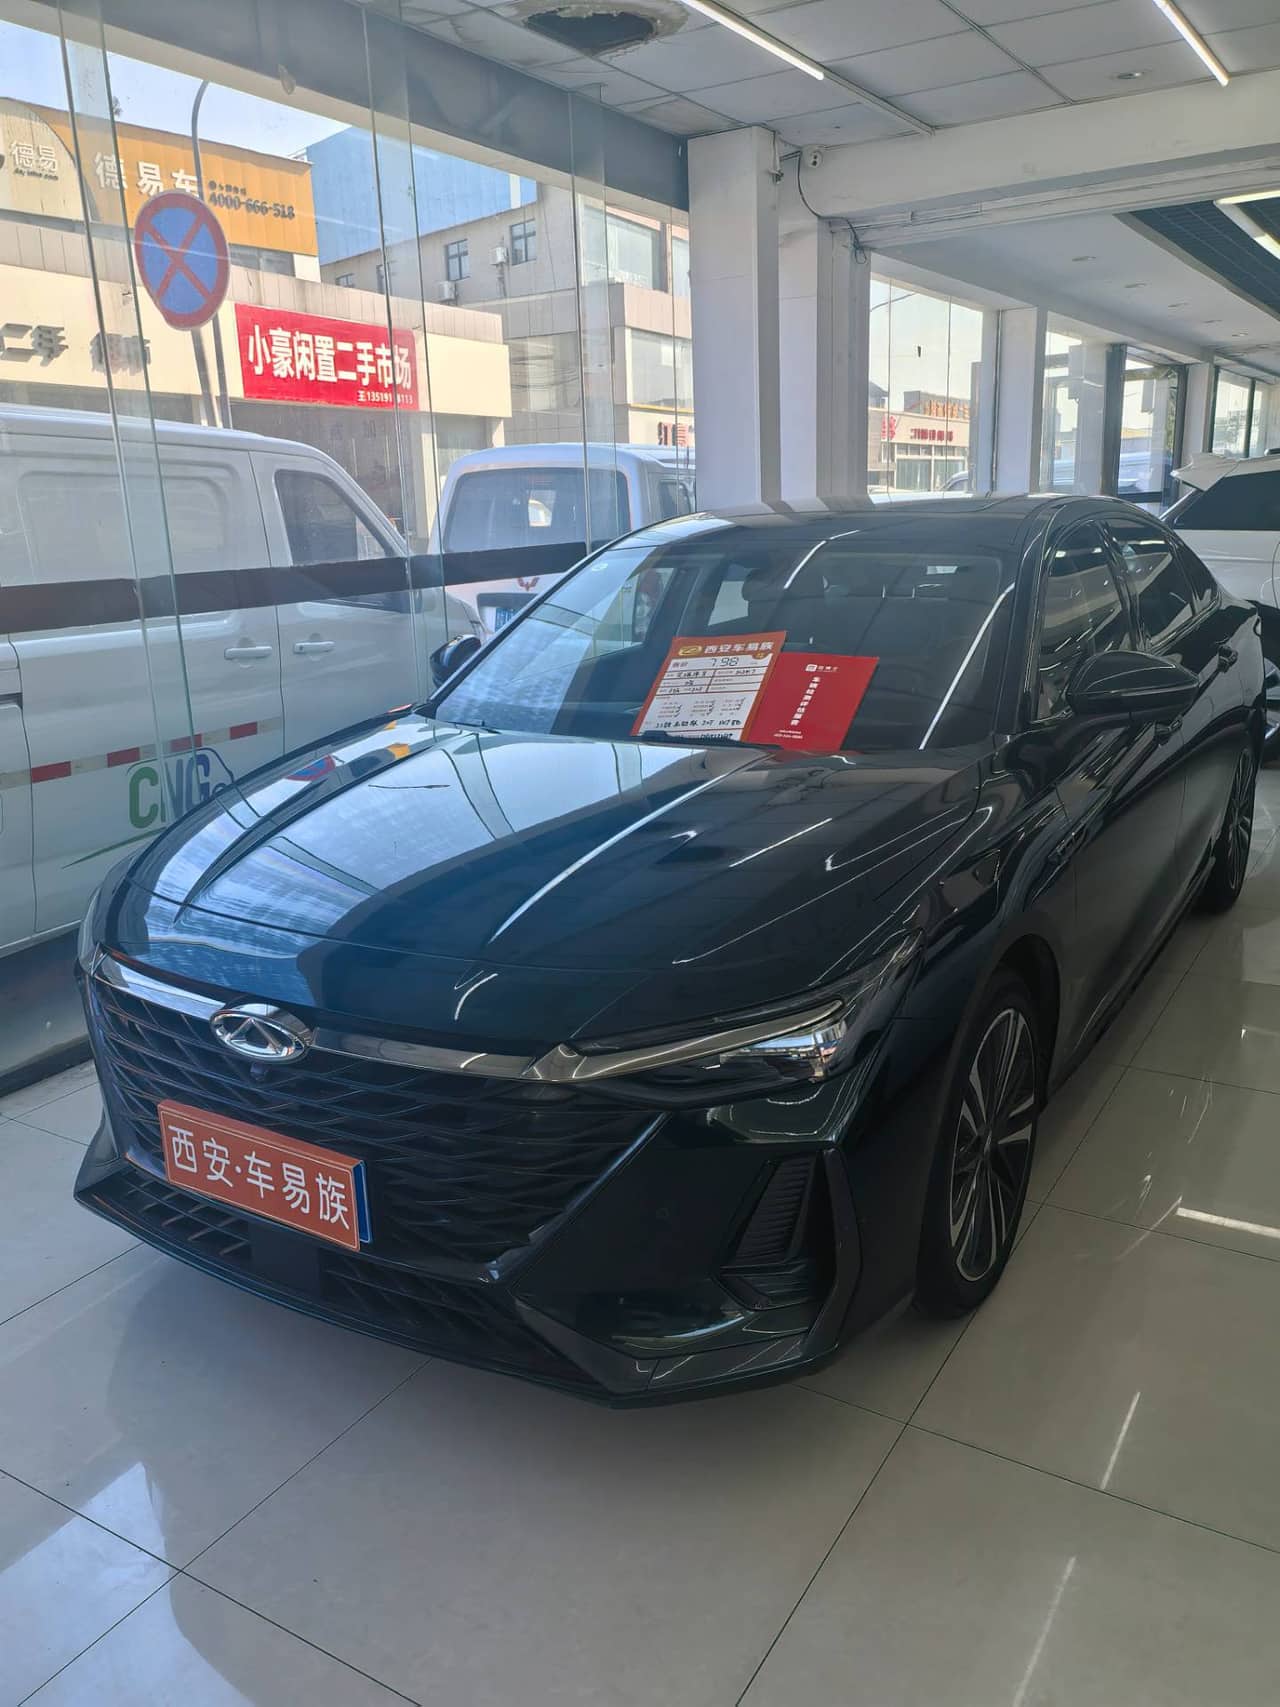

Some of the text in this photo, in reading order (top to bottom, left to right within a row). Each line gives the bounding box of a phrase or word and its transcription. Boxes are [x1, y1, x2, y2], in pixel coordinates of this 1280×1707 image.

[10, 140, 58, 173] 德易
[247, 323, 412, 390] 小豪闲置二手市场
[168, 1125, 350, 1230] 西安·车易族
